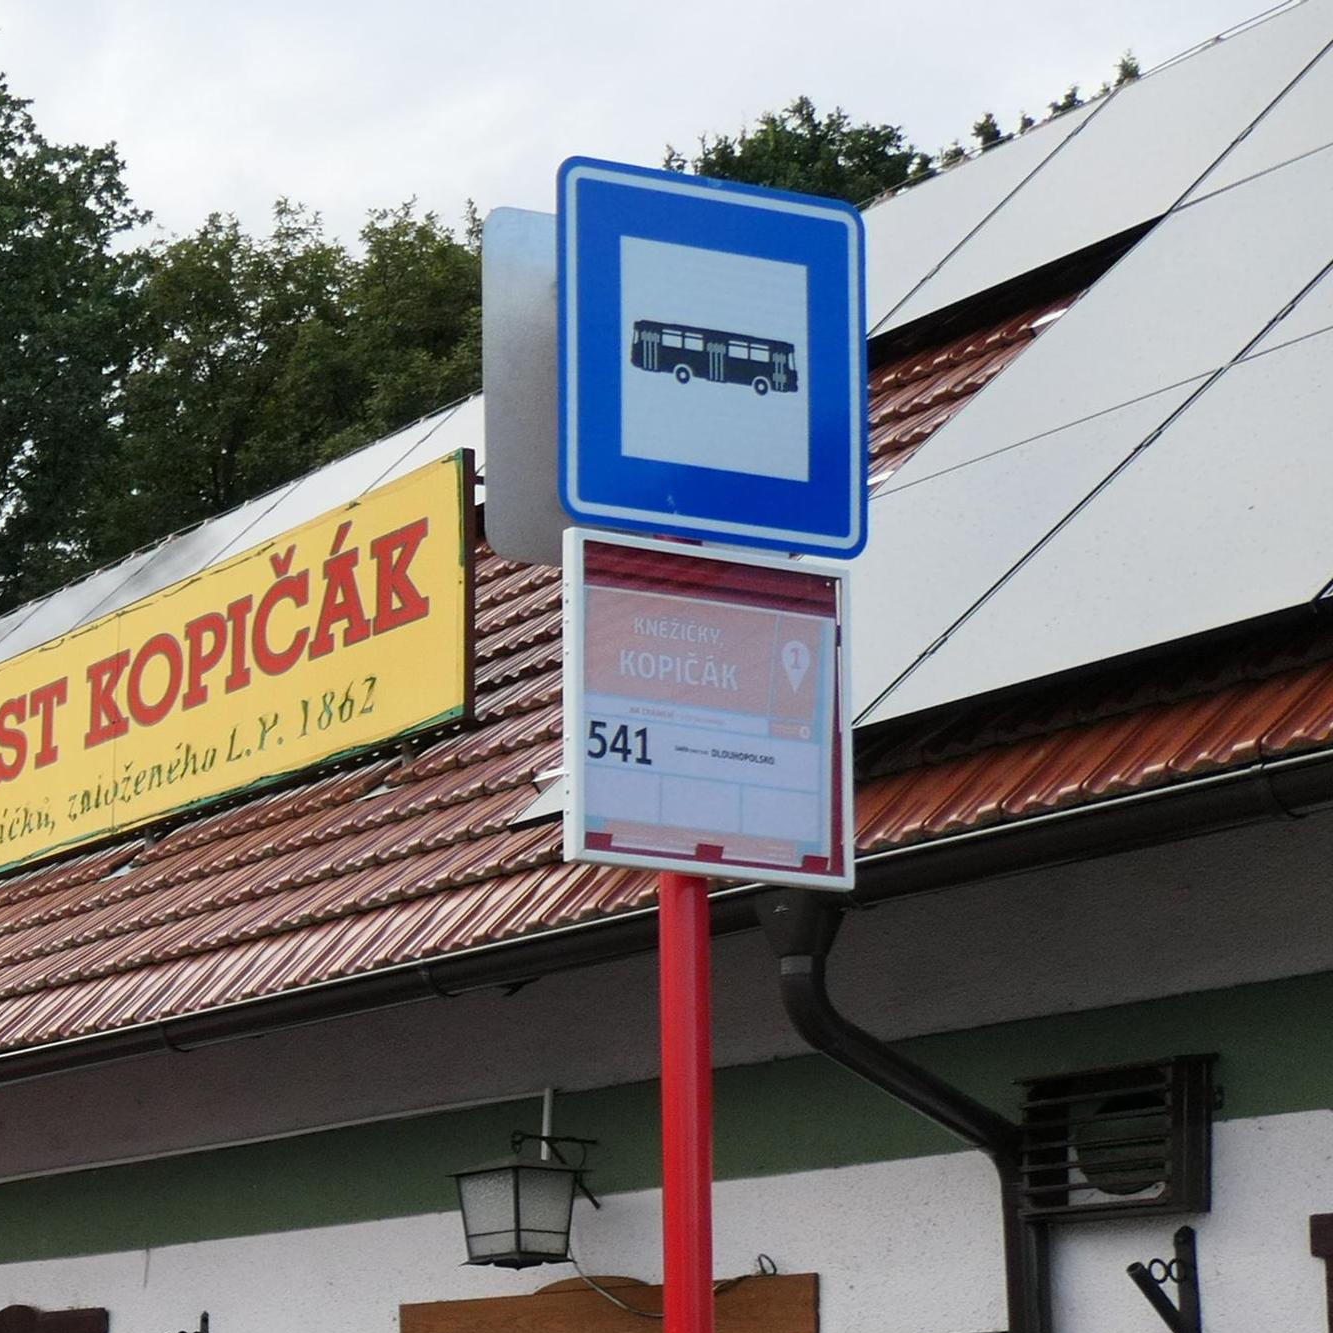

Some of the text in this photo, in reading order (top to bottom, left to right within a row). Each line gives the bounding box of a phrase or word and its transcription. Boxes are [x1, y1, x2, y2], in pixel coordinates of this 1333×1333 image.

[85, 516, 431, 750] KOPIČÁK
[619, 648, 738, 691] KOPIČÁK
[297, 675, 377, 740] 1862
[587, 719, 652, 765] 541
